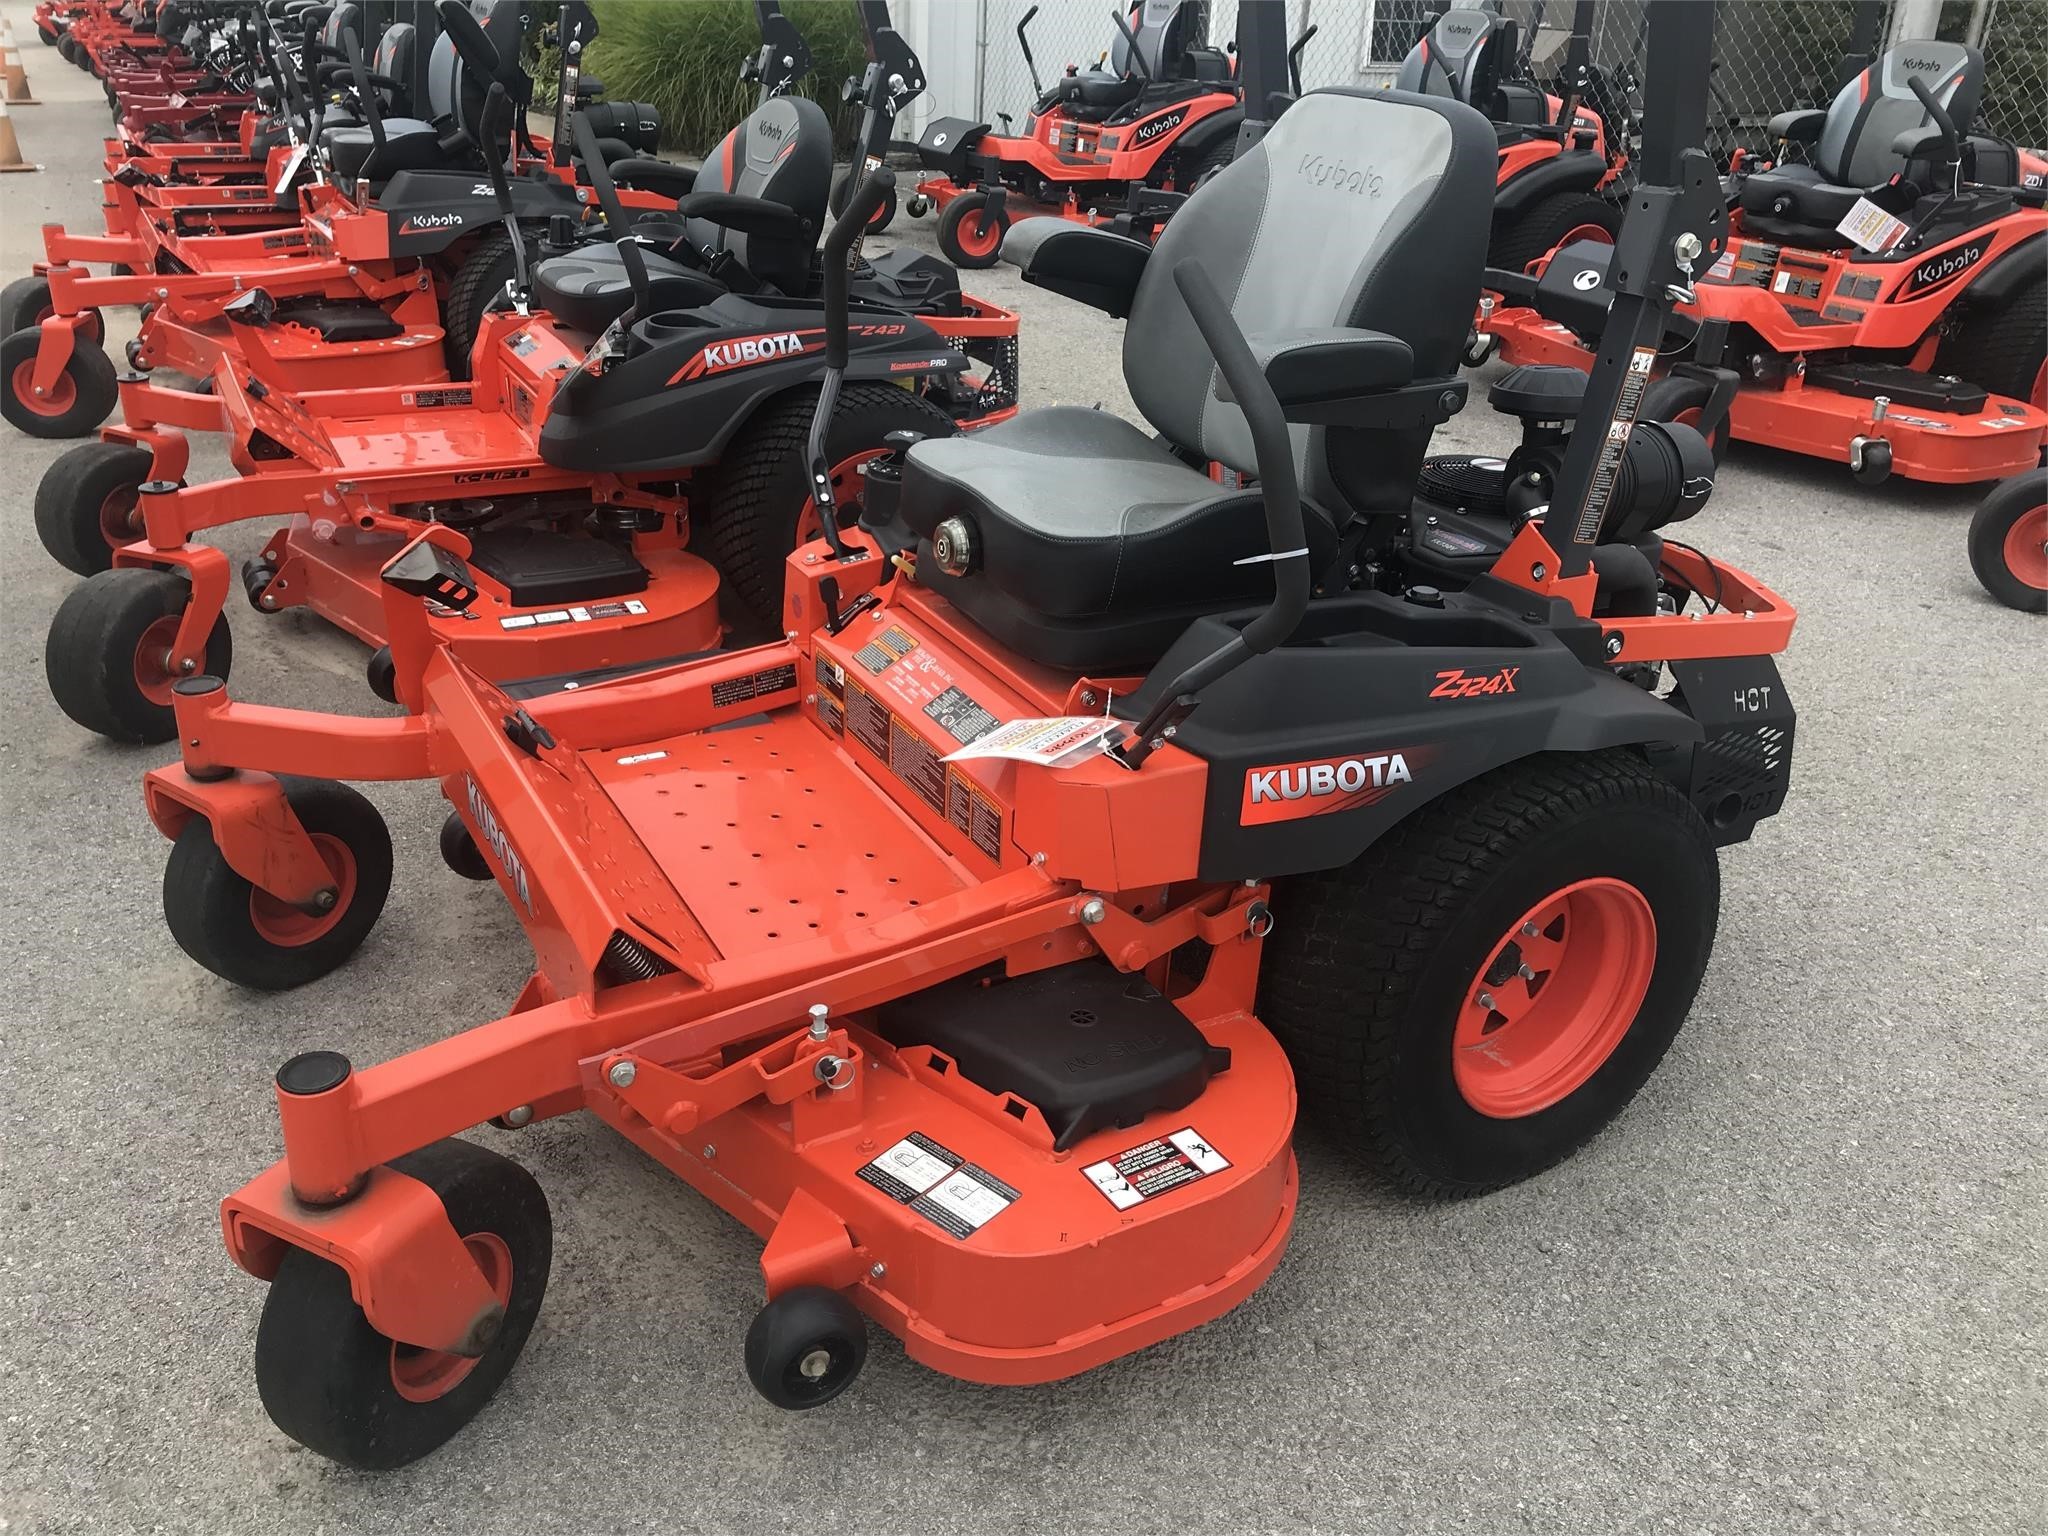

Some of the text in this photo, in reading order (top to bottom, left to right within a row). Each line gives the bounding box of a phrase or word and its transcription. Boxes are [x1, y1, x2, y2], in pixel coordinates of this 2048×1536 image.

[1902, 57, 1941, 72] Kubota
[1138, 114, 1180, 138] Kubota
[1298, 153, 1384, 198] Kubota
[412, 212, 463, 228] Kubota
[1917, 247, 1980, 284] Kubota
[860, 324, 906, 336] Z421
[704, 333, 805, 369] KUBOTA
[457, 470, 529, 484] K-LIFT
[1428, 667, 1521, 699] Z724X
[1734, 686, 1771, 713] HOT
[1251, 753, 1413, 803] KUBOTA
[466, 773, 534, 920] KUBOTA
[1126, 1140, 1162, 1158] DANGER
[1143, 1160, 1182, 1178] PELIGRO
